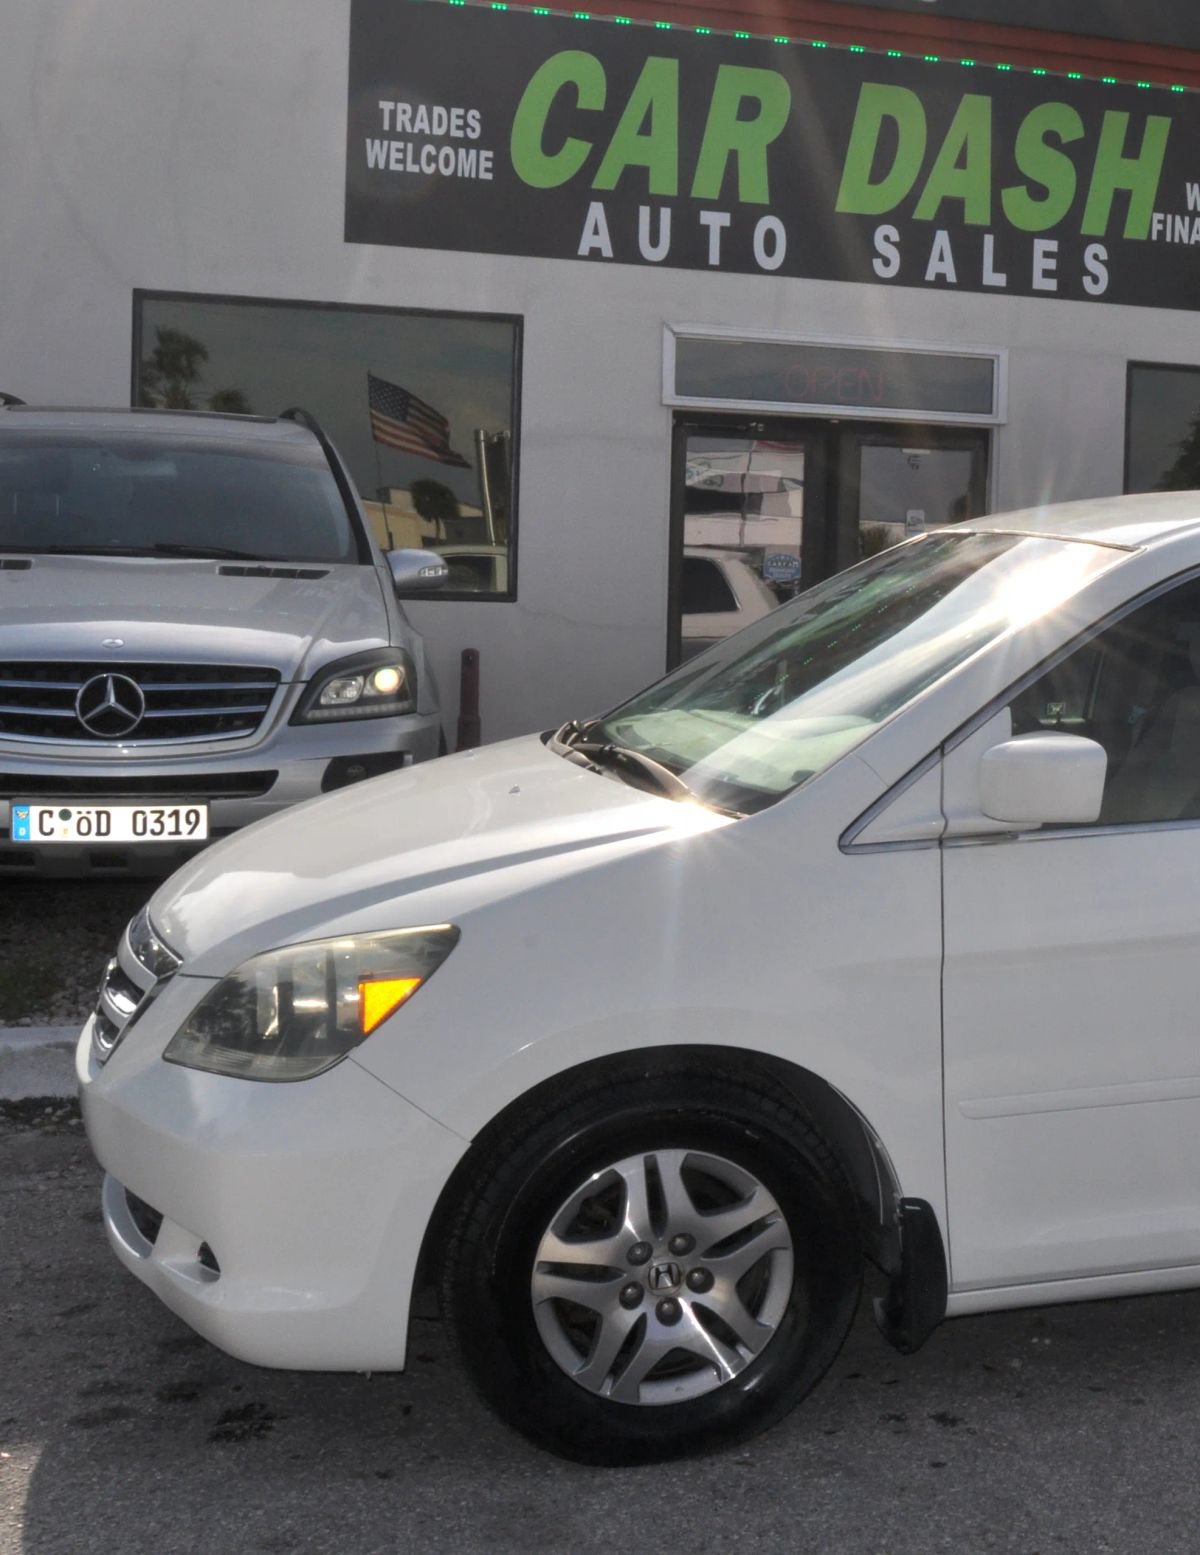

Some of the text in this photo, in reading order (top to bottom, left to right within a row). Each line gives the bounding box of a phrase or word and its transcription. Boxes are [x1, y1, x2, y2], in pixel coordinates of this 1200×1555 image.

[378, 100, 482, 140] TRADES
[365, 138, 494, 181] WELCOME
[510, 50, 1172, 241] CAR DASH
[577, 201, 1110, 296] AUTO SALES
[784, 364, 884, 402] OPEN
[38, 809, 54, 837] C
[132, 809, 201, 837] 0319
